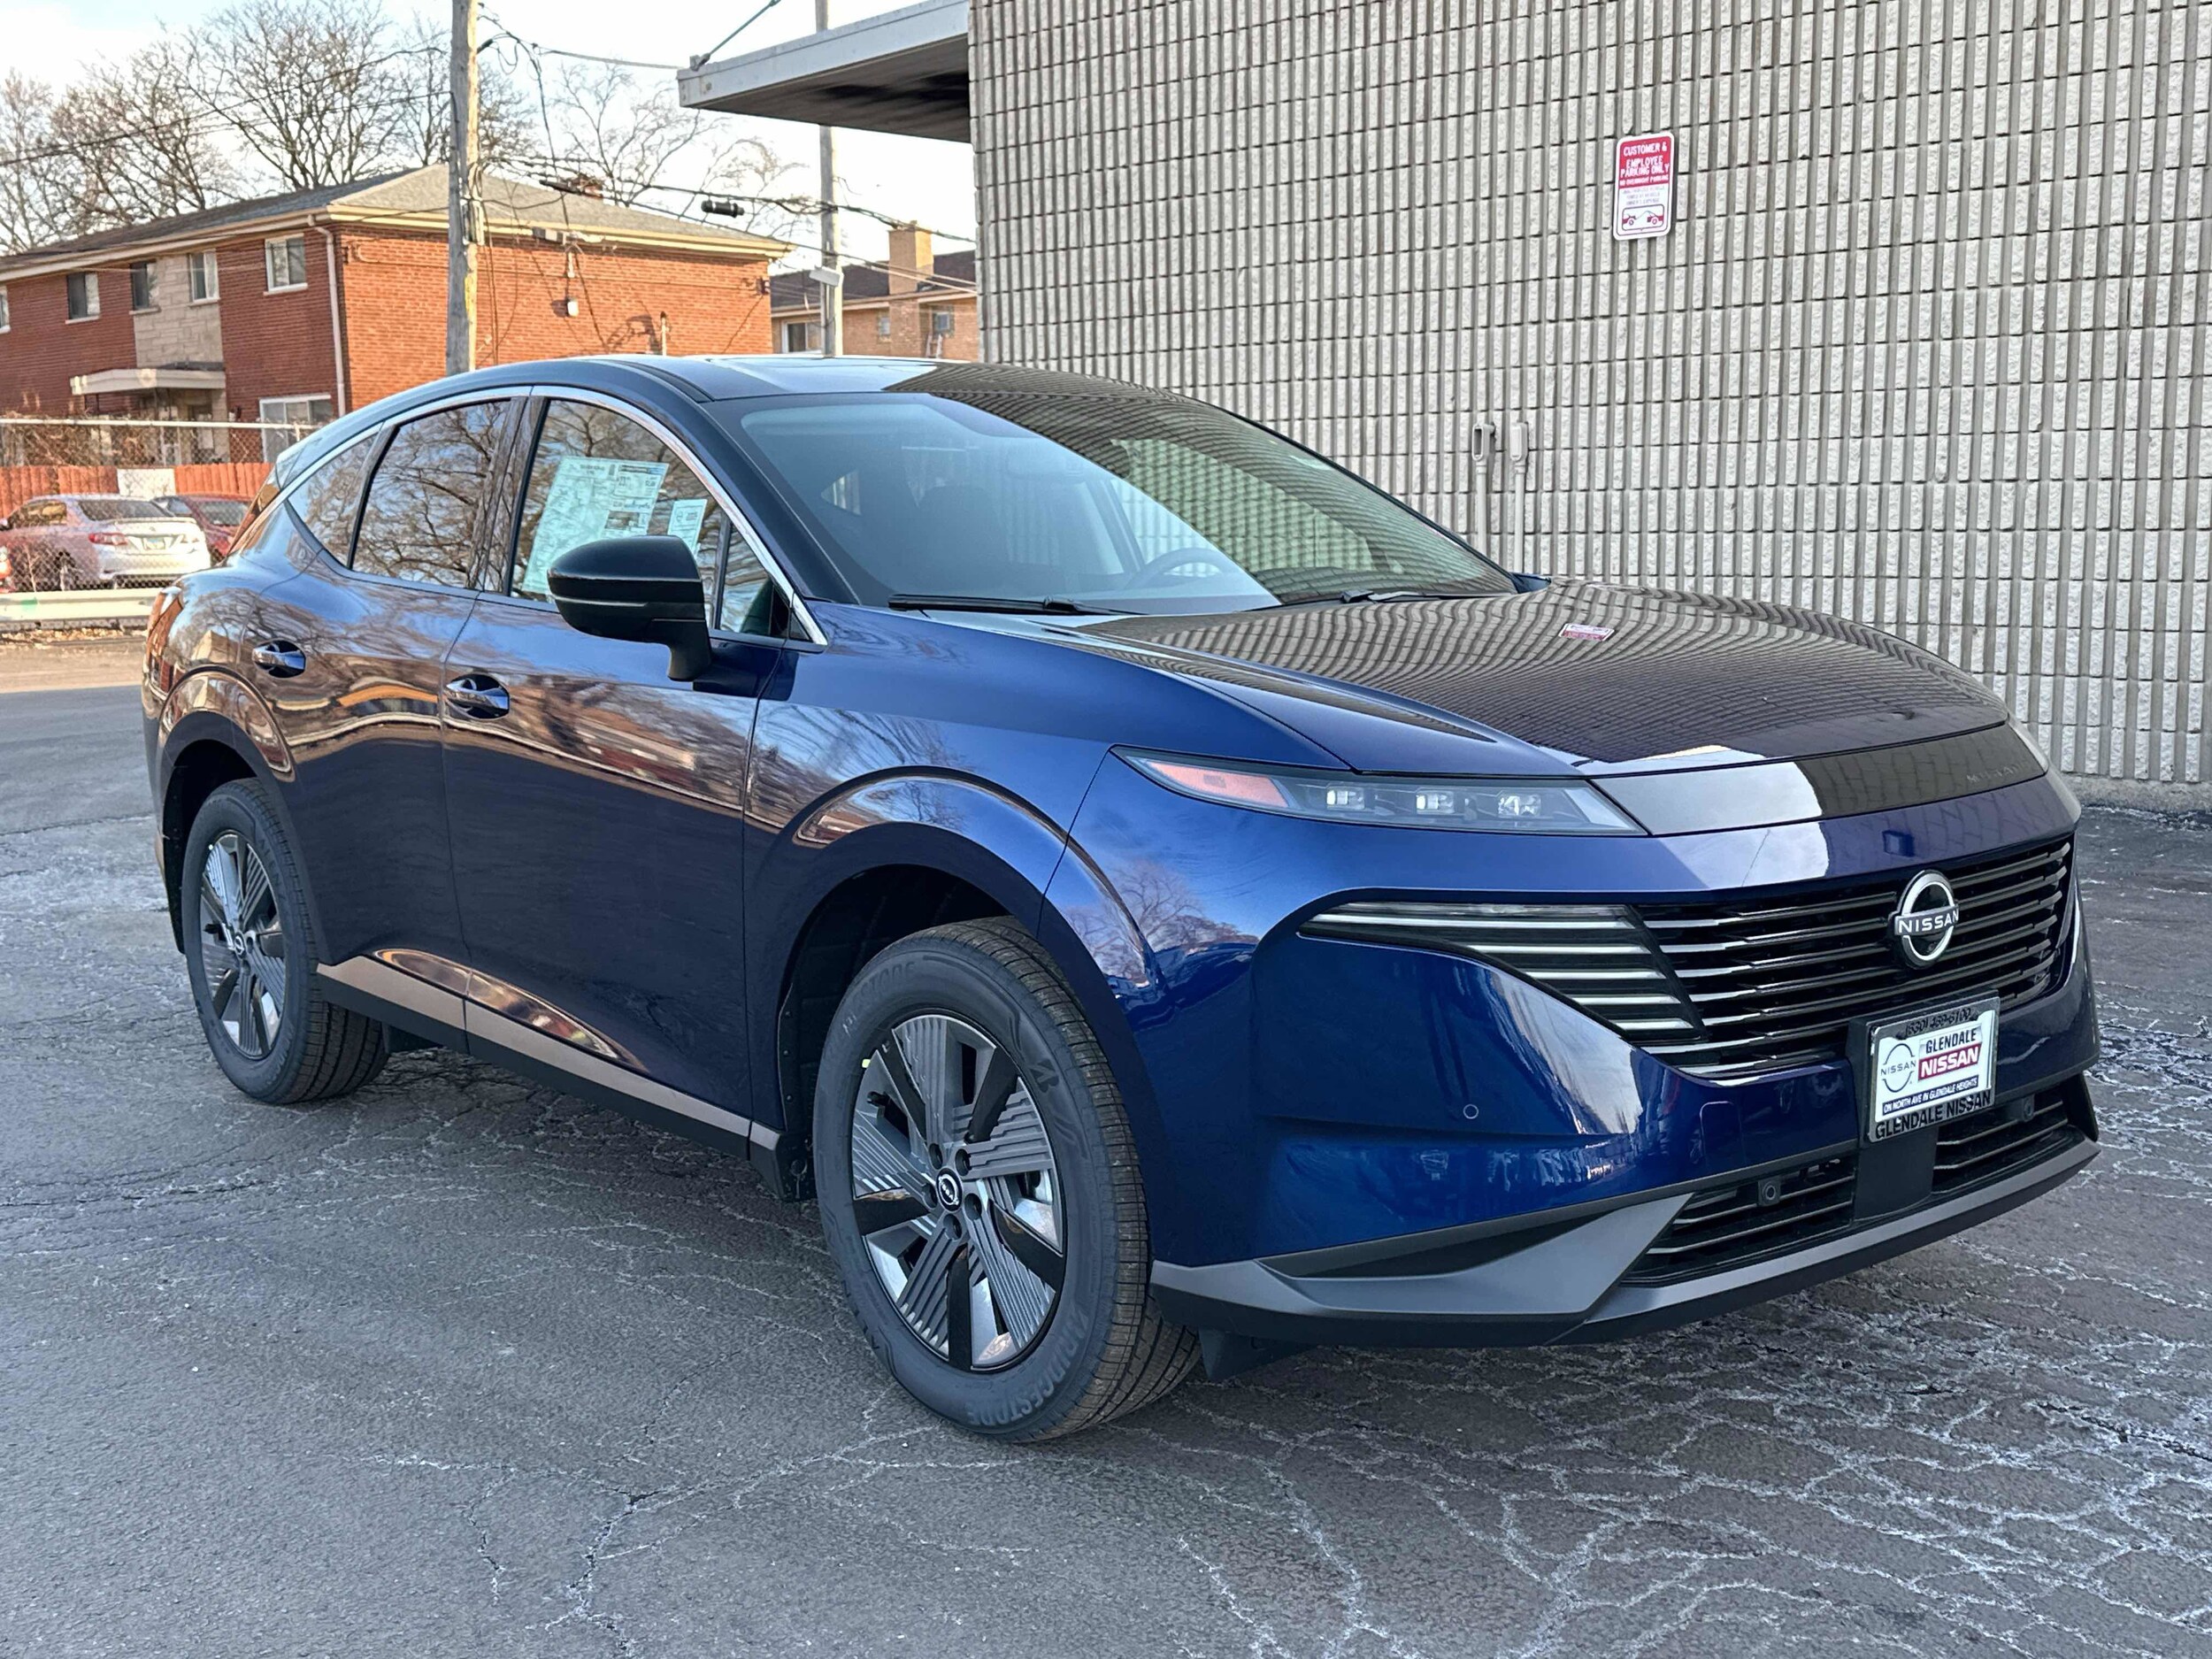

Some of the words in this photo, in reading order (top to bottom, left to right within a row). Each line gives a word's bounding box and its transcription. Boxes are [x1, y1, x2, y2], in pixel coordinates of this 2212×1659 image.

[1624, 142, 1661, 157] CUSTOMER
[1662, 142, 1667, 151] &
[1620, 166, 1649, 178] PARKING
[1651, 162, 1670, 174] ONLY
[1626, 155, 1663, 169] EMPLOYEE
[1898, 909, 1959, 933] NISSAN
[1925, 1027, 1977, 1054] GLENDALE
[1880, 1059, 1916, 1076] NISSAN
[1921, 1047, 1978, 1078] NISSAN
[1883, 1103, 1891, 1113] ON
[1893, 1096, 1911, 1110] NORTH
[1911, 1094, 1922, 1106] AVE
[1922, 1092, 1930, 1102] IN
[1930, 1084, 1956, 1100] GLENDALE
[1956, 1078, 1978, 1091] HEIGHTS
[1876, 1104, 1943, 1139] GLENDALE
[1946, 1090, 1991, 1116] NISSAN
